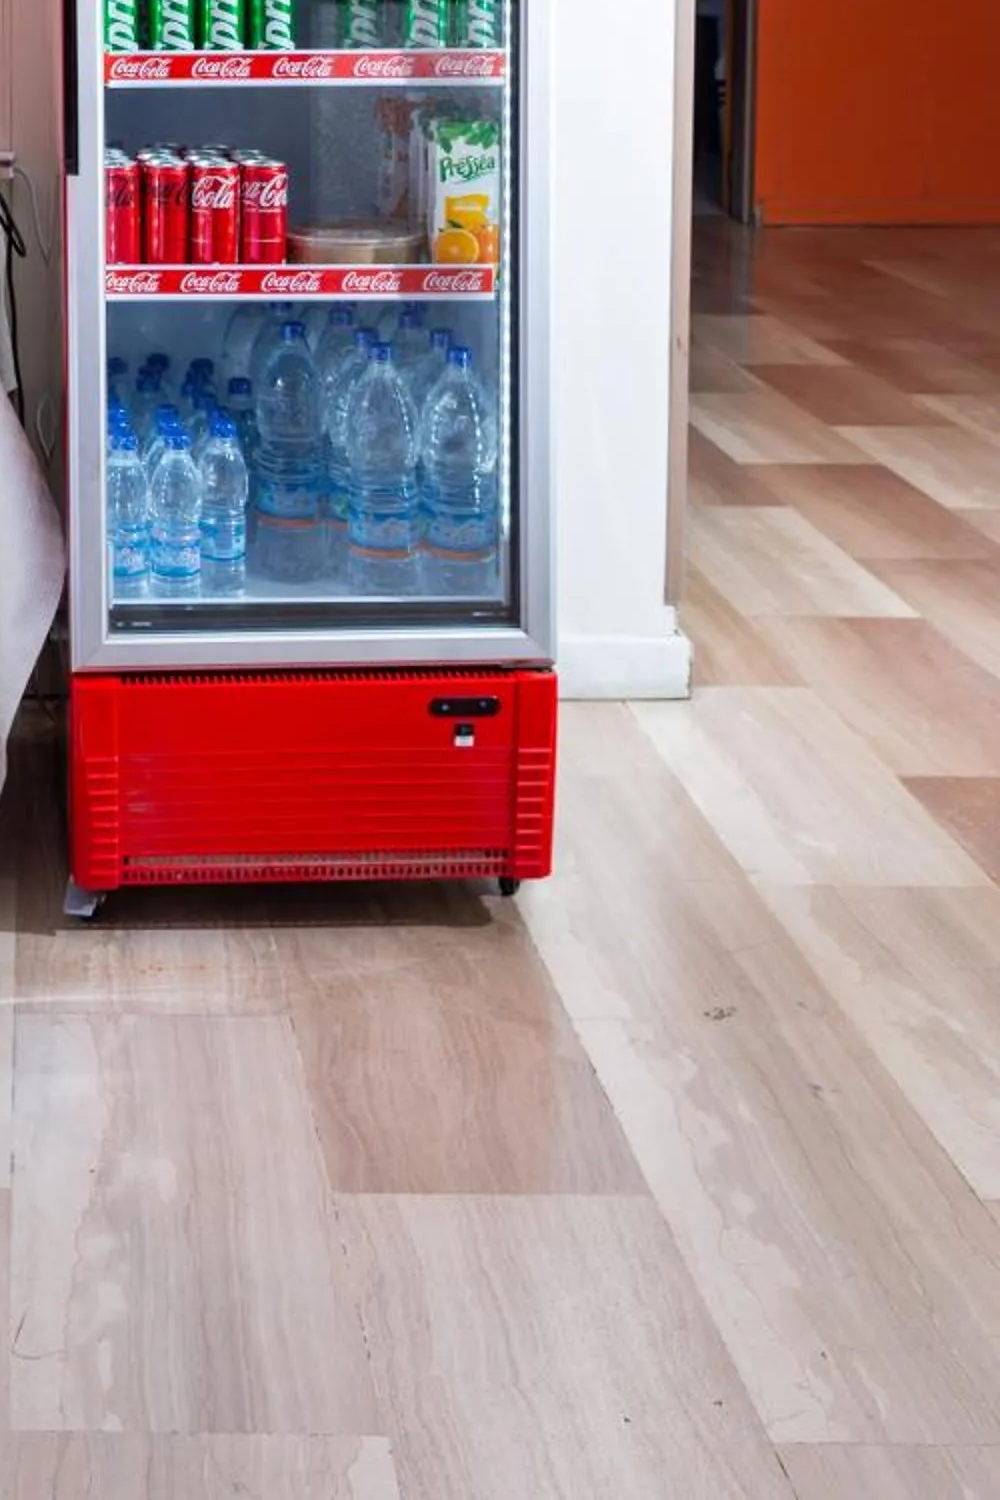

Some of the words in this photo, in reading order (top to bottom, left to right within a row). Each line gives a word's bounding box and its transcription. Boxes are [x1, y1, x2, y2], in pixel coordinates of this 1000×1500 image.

[110, 57, 172, 79] Coca-Cola
[191, 57, 254, 79] Coca-Cola
[272, 57, 335, 78] Coca-Cola
[353, 56, 415, 77] Coca-Cola
[180, 271, 243, 293] Coca-Cola
[261, 271, 322, 293] Coca-Cola
[342, 271, 405, 292] Coca-Cola
[423, 270, 484, 291] Coca-Cola
